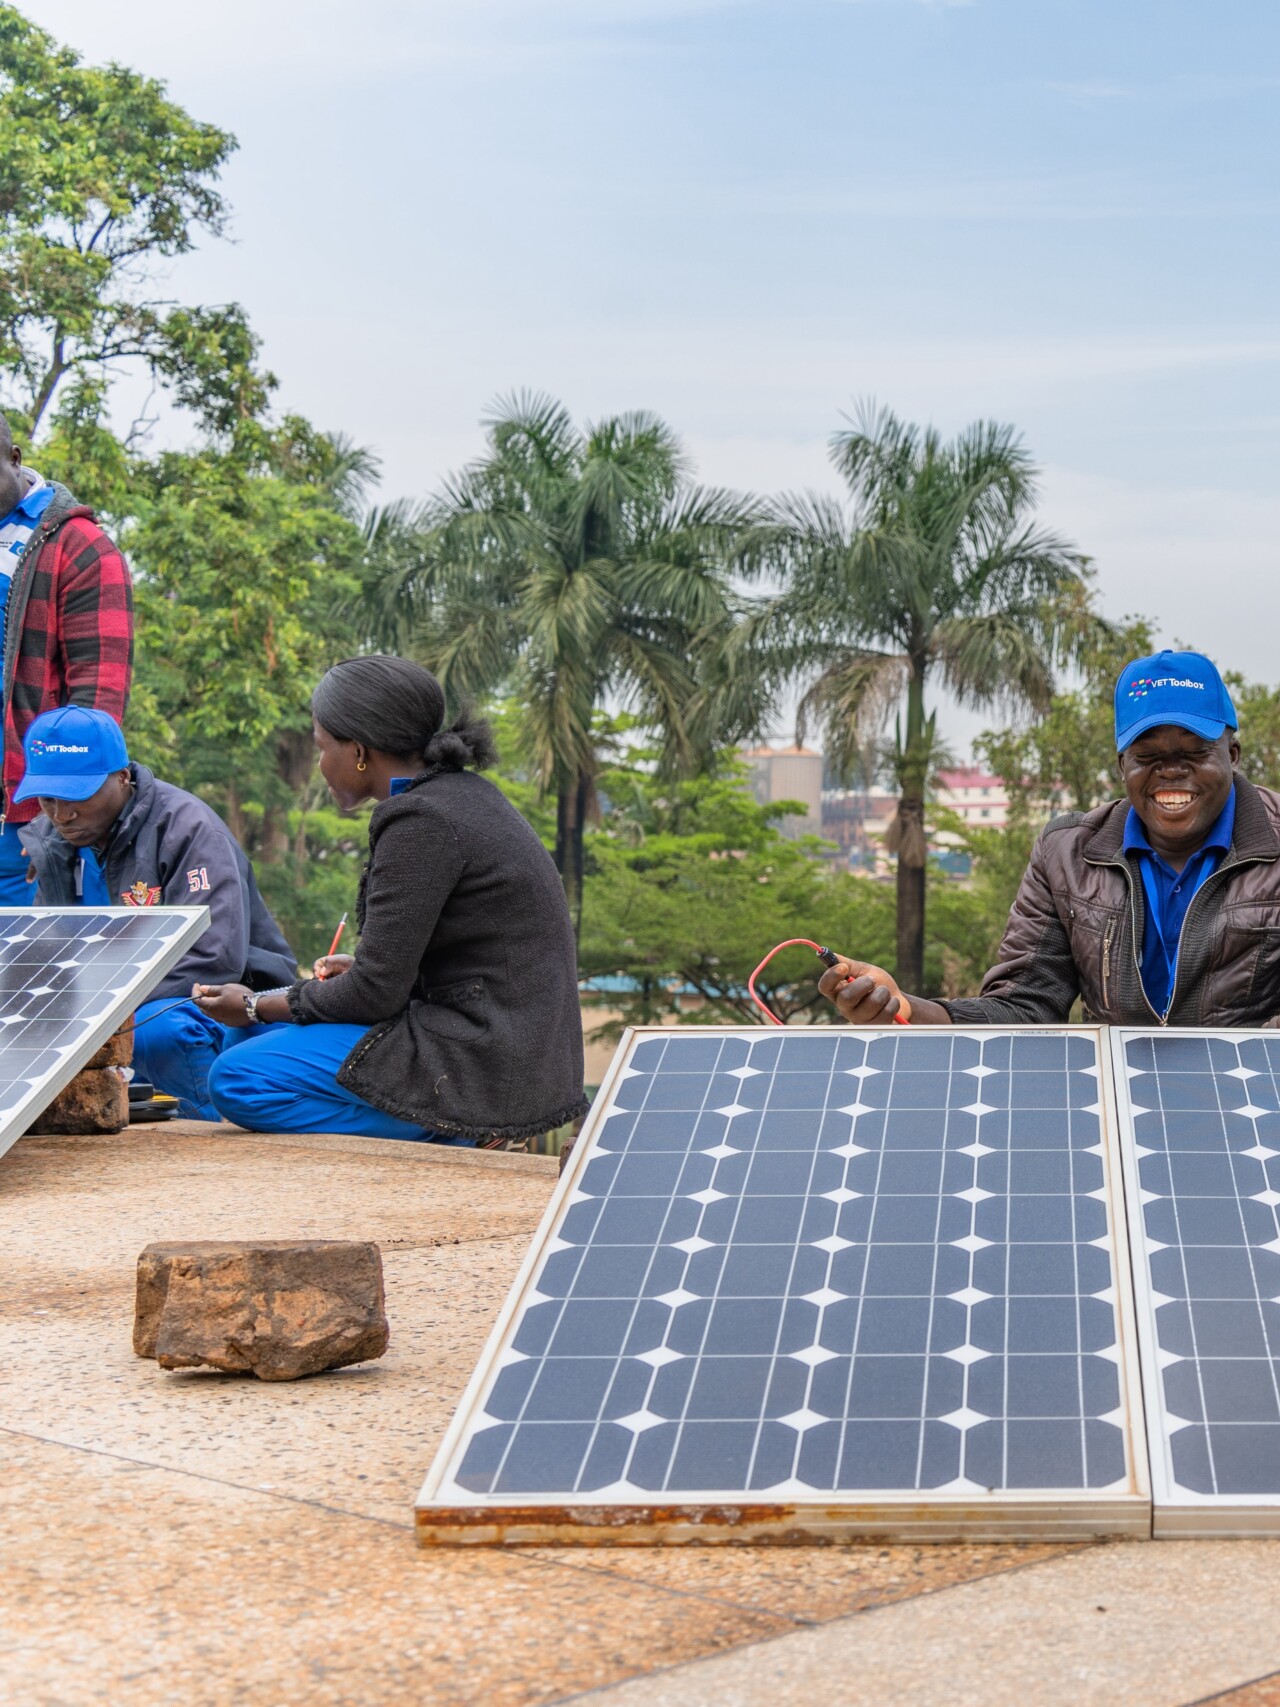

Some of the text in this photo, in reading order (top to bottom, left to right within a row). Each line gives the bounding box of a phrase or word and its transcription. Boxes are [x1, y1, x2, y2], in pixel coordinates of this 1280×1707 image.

[1151, 678, 1204, 690] VET Toolbox
[45, 744, 89, 753] VET Toolbox
[186, 867, 211, 893] 51
